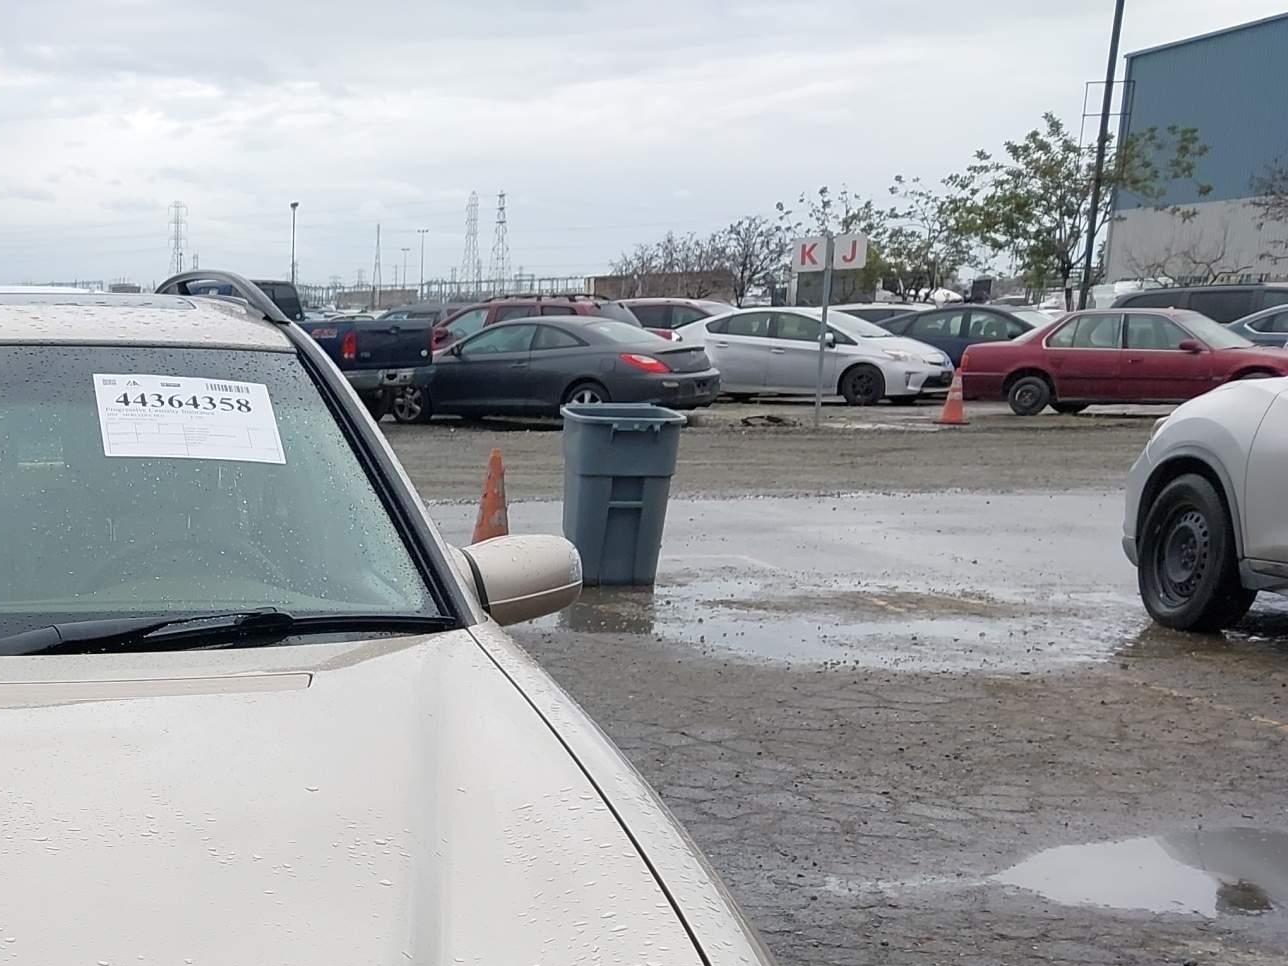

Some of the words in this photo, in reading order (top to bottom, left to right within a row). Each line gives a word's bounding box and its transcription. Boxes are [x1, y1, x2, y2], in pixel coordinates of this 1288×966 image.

[800, 243, 818, 265] K
[841, 240, 857, 263] J
[115, 392, 252, 413] 44364358
